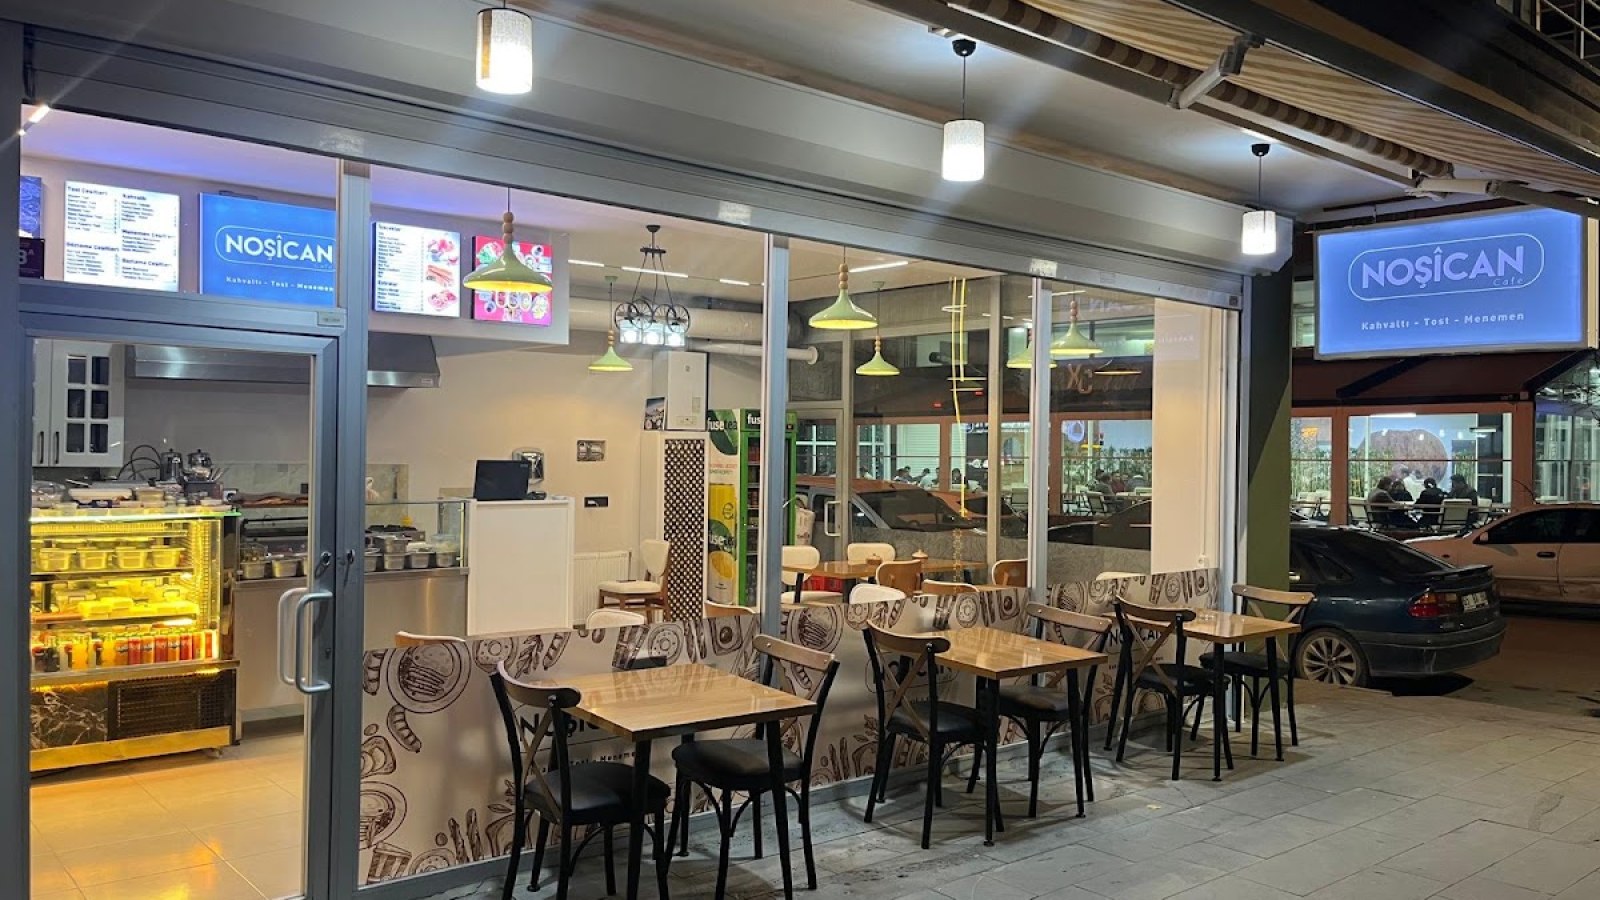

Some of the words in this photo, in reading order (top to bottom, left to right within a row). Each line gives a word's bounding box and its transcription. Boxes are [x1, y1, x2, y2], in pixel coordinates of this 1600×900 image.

[1362, 246, 1524, 289] NOŞÎCAN
[1493, 277, 1525, 287] Cafe
[1361, 319, 1410, 331] Kahvaltı
[1424, 316, 1449, 327] Tost
[1464, 311, 1525, 325] Menemen
